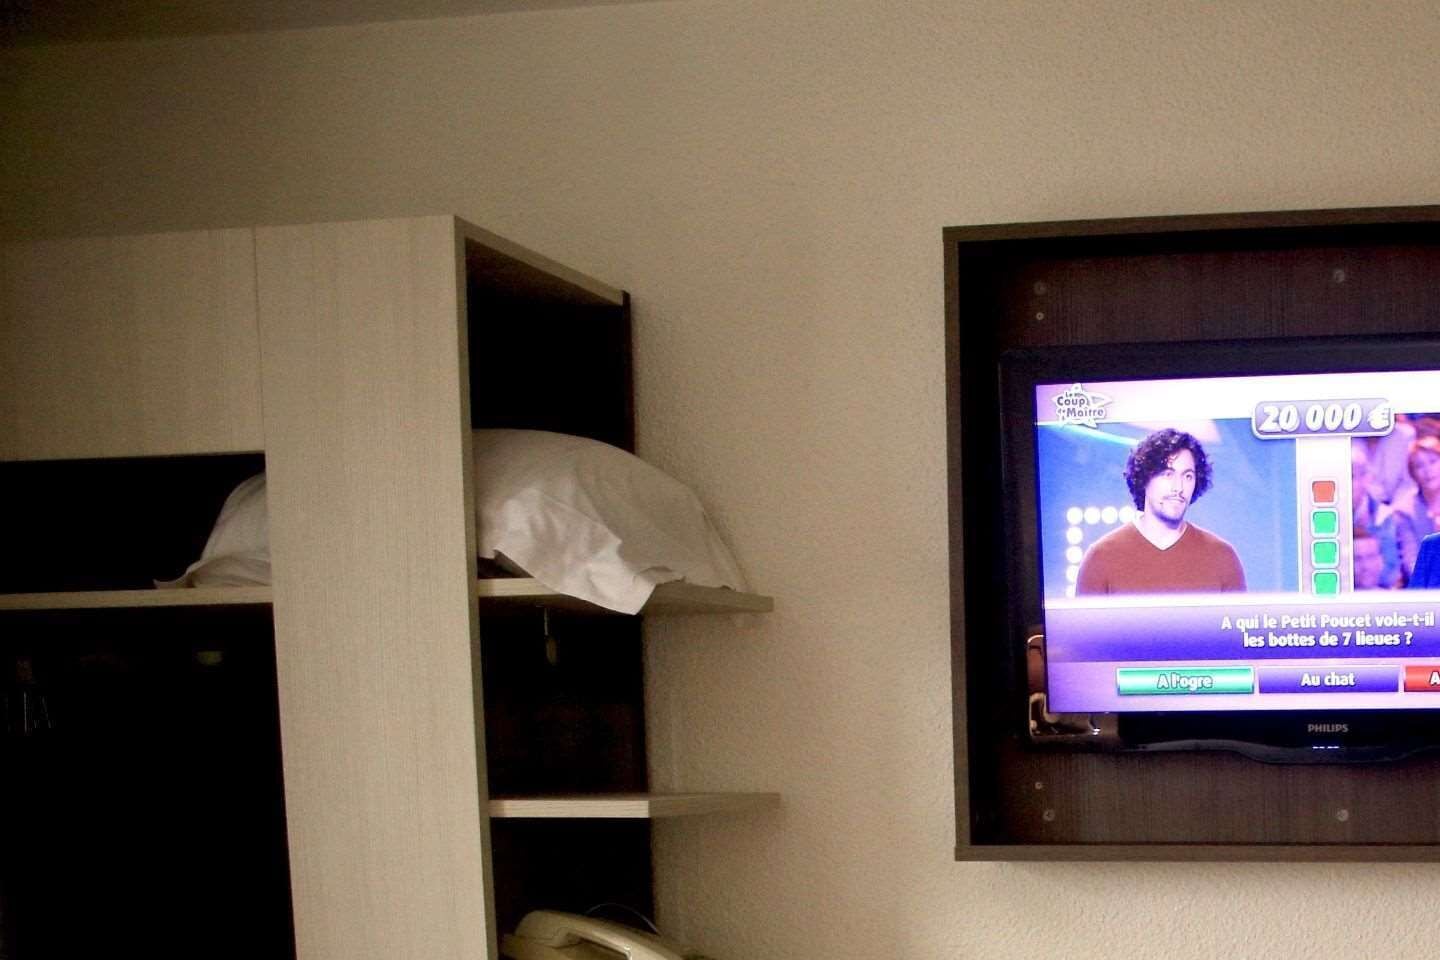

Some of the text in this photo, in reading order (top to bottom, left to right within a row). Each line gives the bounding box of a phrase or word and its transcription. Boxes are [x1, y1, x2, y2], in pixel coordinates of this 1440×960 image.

[1056, 395, 1086, 408] Coup
[1259, 402, 1391, 433] 20 000 €
[1221, 611, 1435, 633] A qui le Petit Poucet vole-t-il
[1243, 630, 1413, 648] les bottes de 7 lieues ?
[1157, 673, 1169, 689] A
[1300, 671, 1356, 687] Au chat
[1307, 723, 1349, 733] PHILIPS
